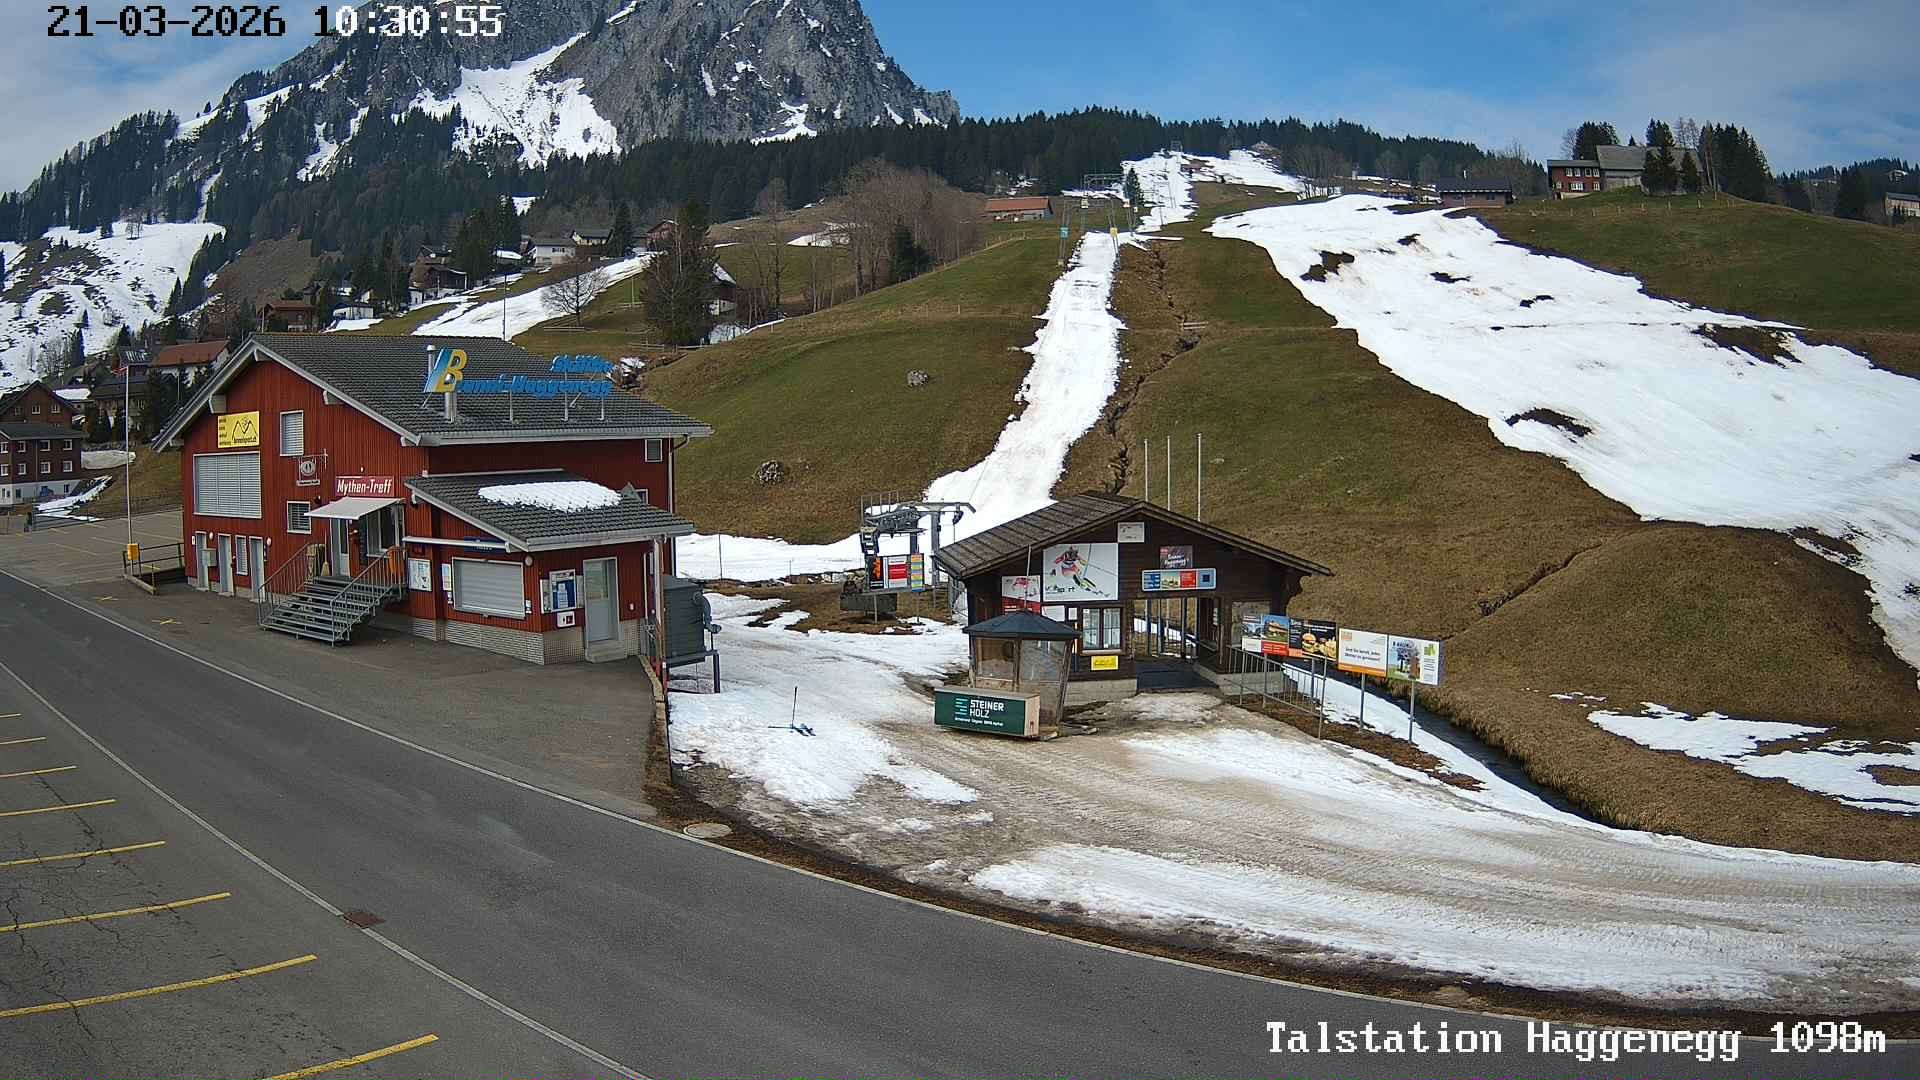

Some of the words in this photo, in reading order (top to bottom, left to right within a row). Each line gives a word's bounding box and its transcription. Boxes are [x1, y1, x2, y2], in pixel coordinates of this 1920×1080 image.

[337, 479, 392, 496] Mythen-Treff
[970, 699, 1005, 712] STEINER
[969, 708, 990, 718] HOLZ
